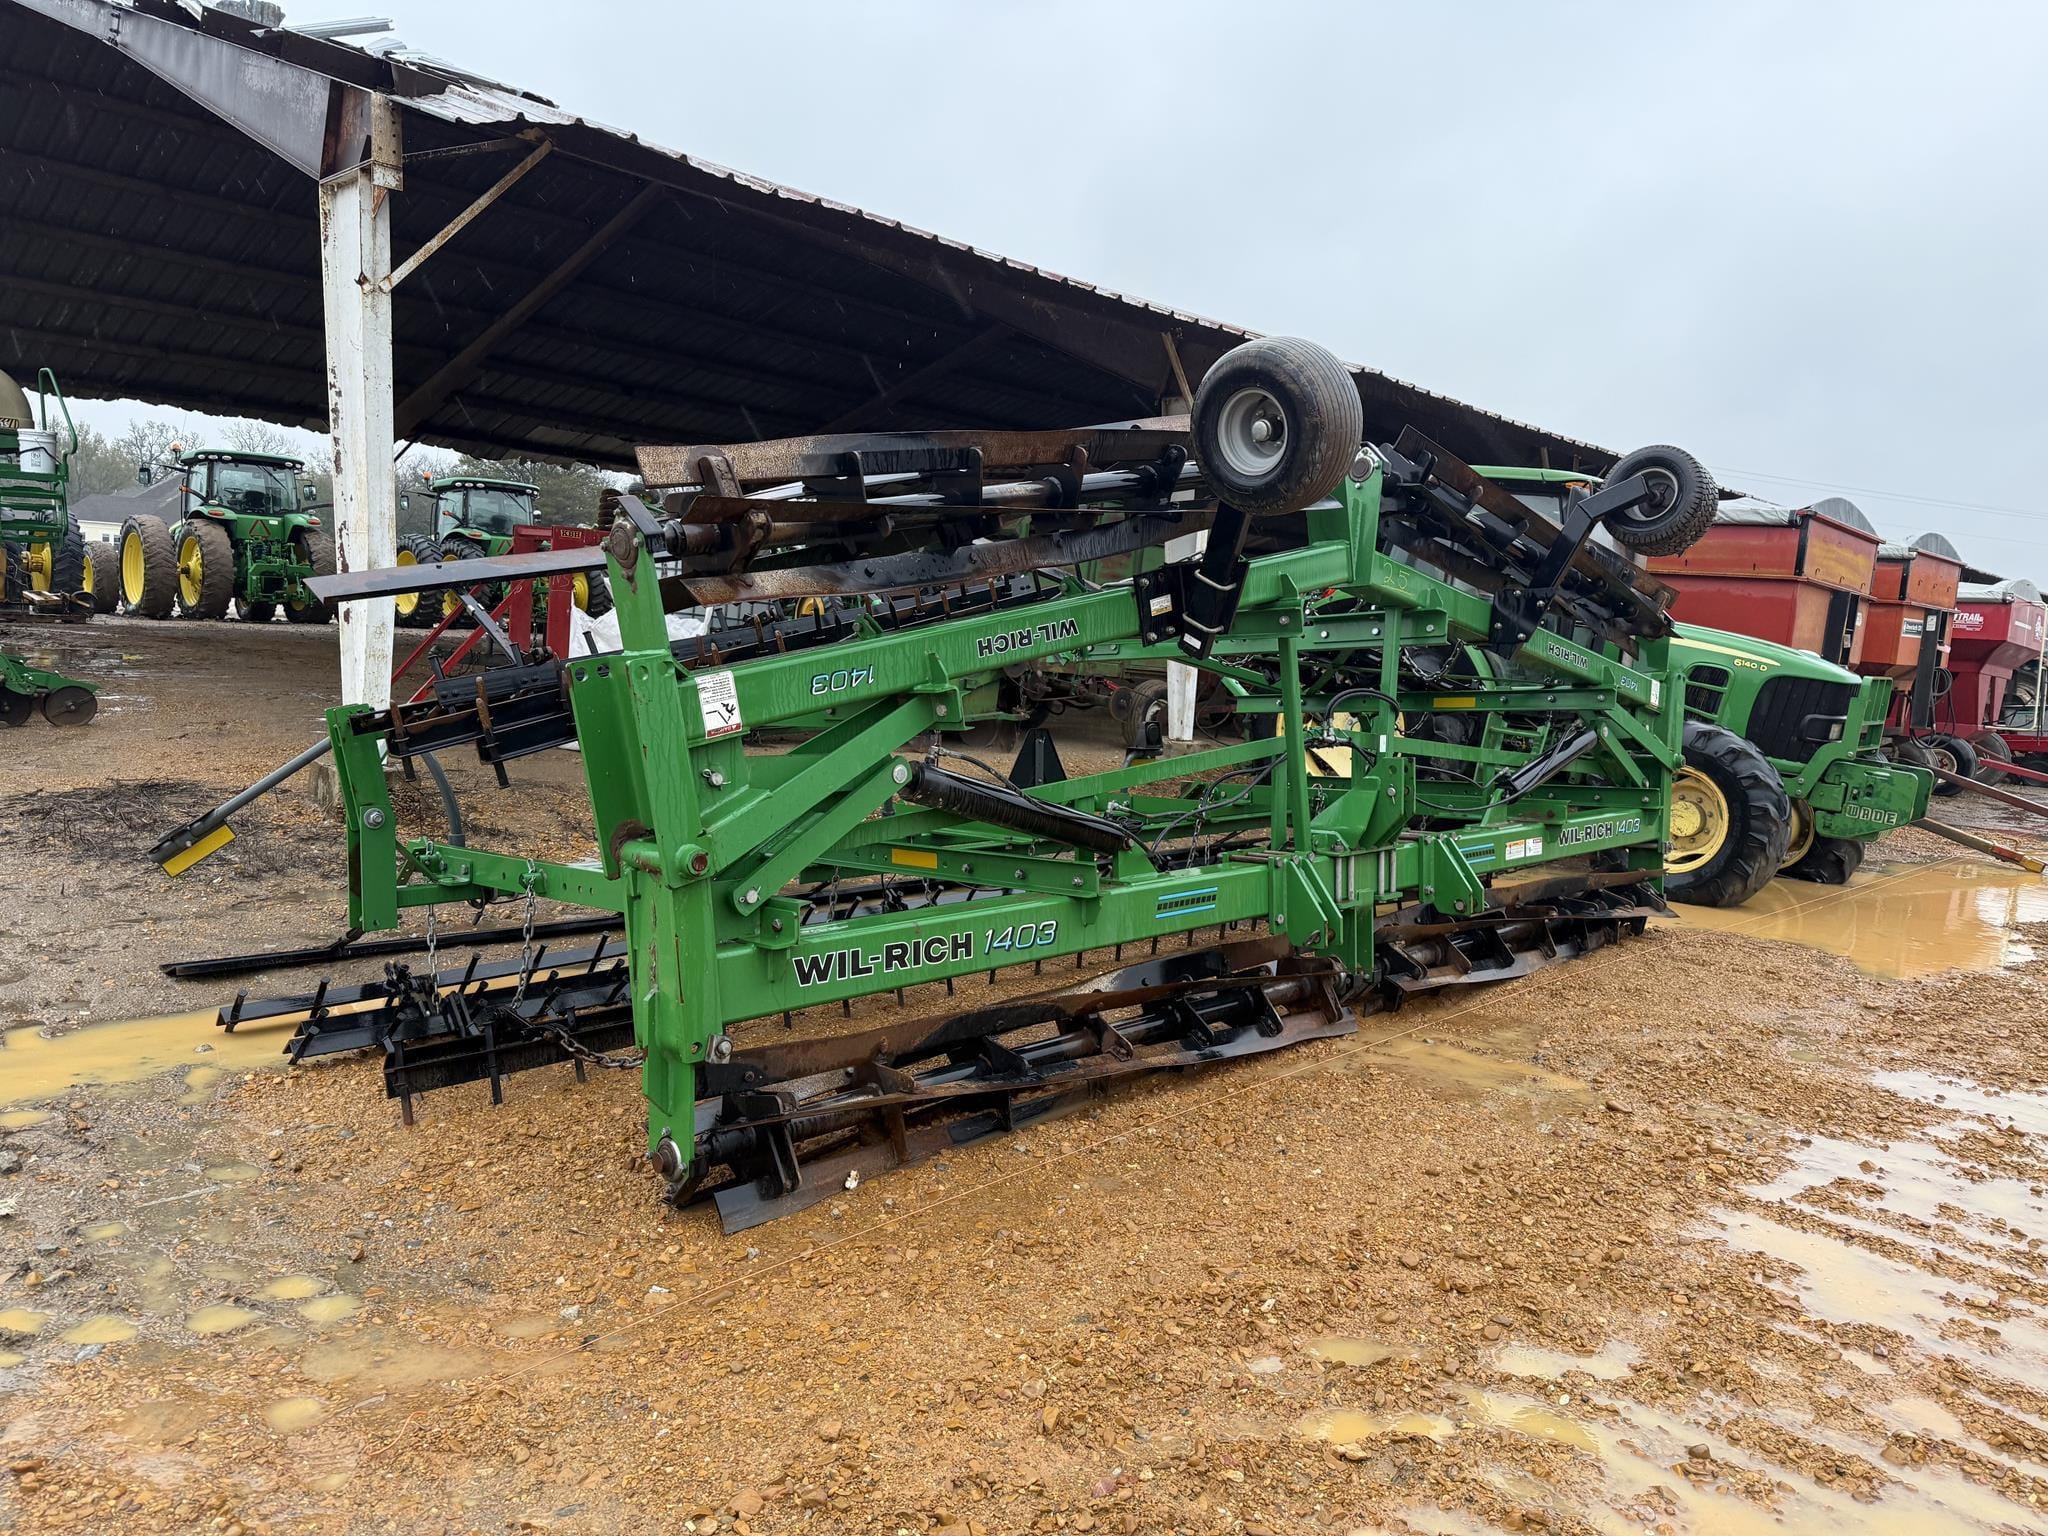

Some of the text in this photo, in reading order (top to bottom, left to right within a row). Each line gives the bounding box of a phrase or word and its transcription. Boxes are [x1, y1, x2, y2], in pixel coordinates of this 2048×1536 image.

[1383, 562, 1410, 590] 25
[811, 618, 1079, 695] WIL-RICH 1403
[1548, 642, 1638, 691] WIL-RICH 1403
[1734, 658, 1757, 669] 6140
[1845, 804, 1898, 825] WADE
[1558, 822, 1614, 847] WIL-RICH
[1615, 818, 1641, 836] 1403
[793, 920, 1057, 987] WIL-RICH 1403
